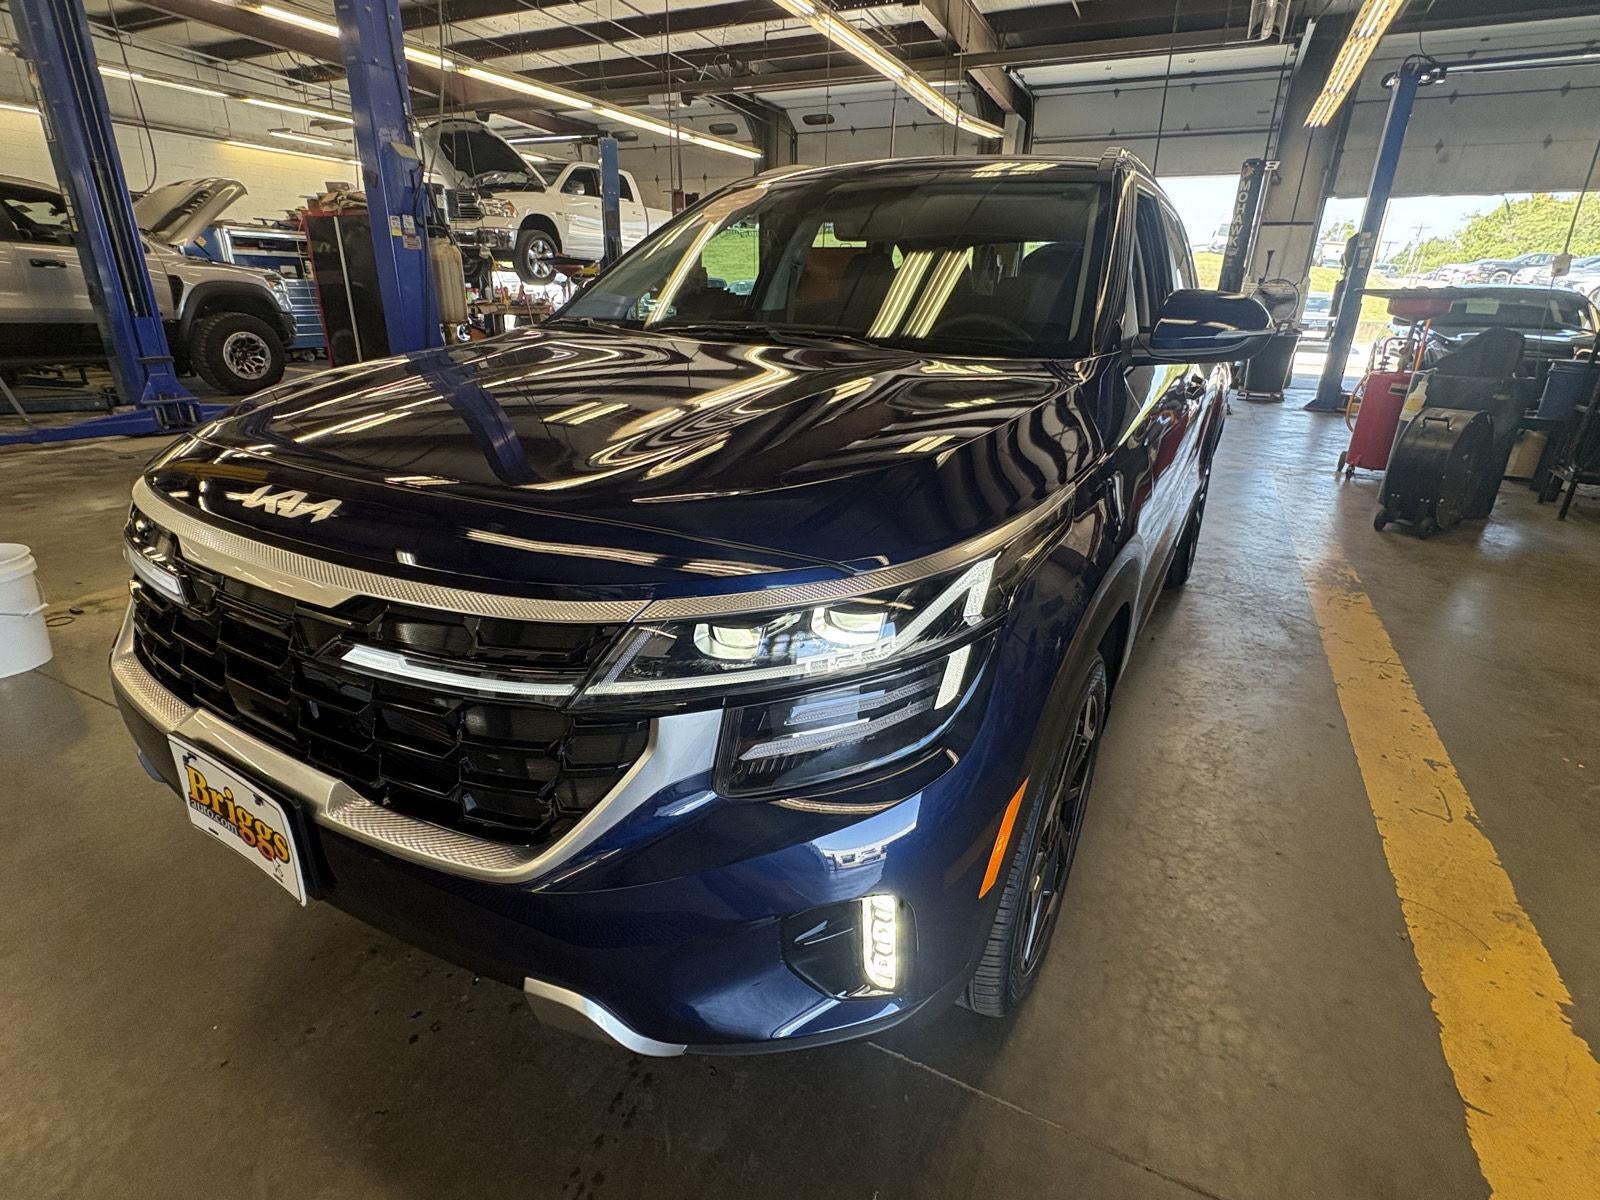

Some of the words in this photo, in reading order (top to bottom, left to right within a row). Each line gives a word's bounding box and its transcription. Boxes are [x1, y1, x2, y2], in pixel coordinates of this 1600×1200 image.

[1229, 180, 1251, 247] MOHAWK
[185, 765, 290, 863] Briggs
[189, 801, 241, 837] auto.com
